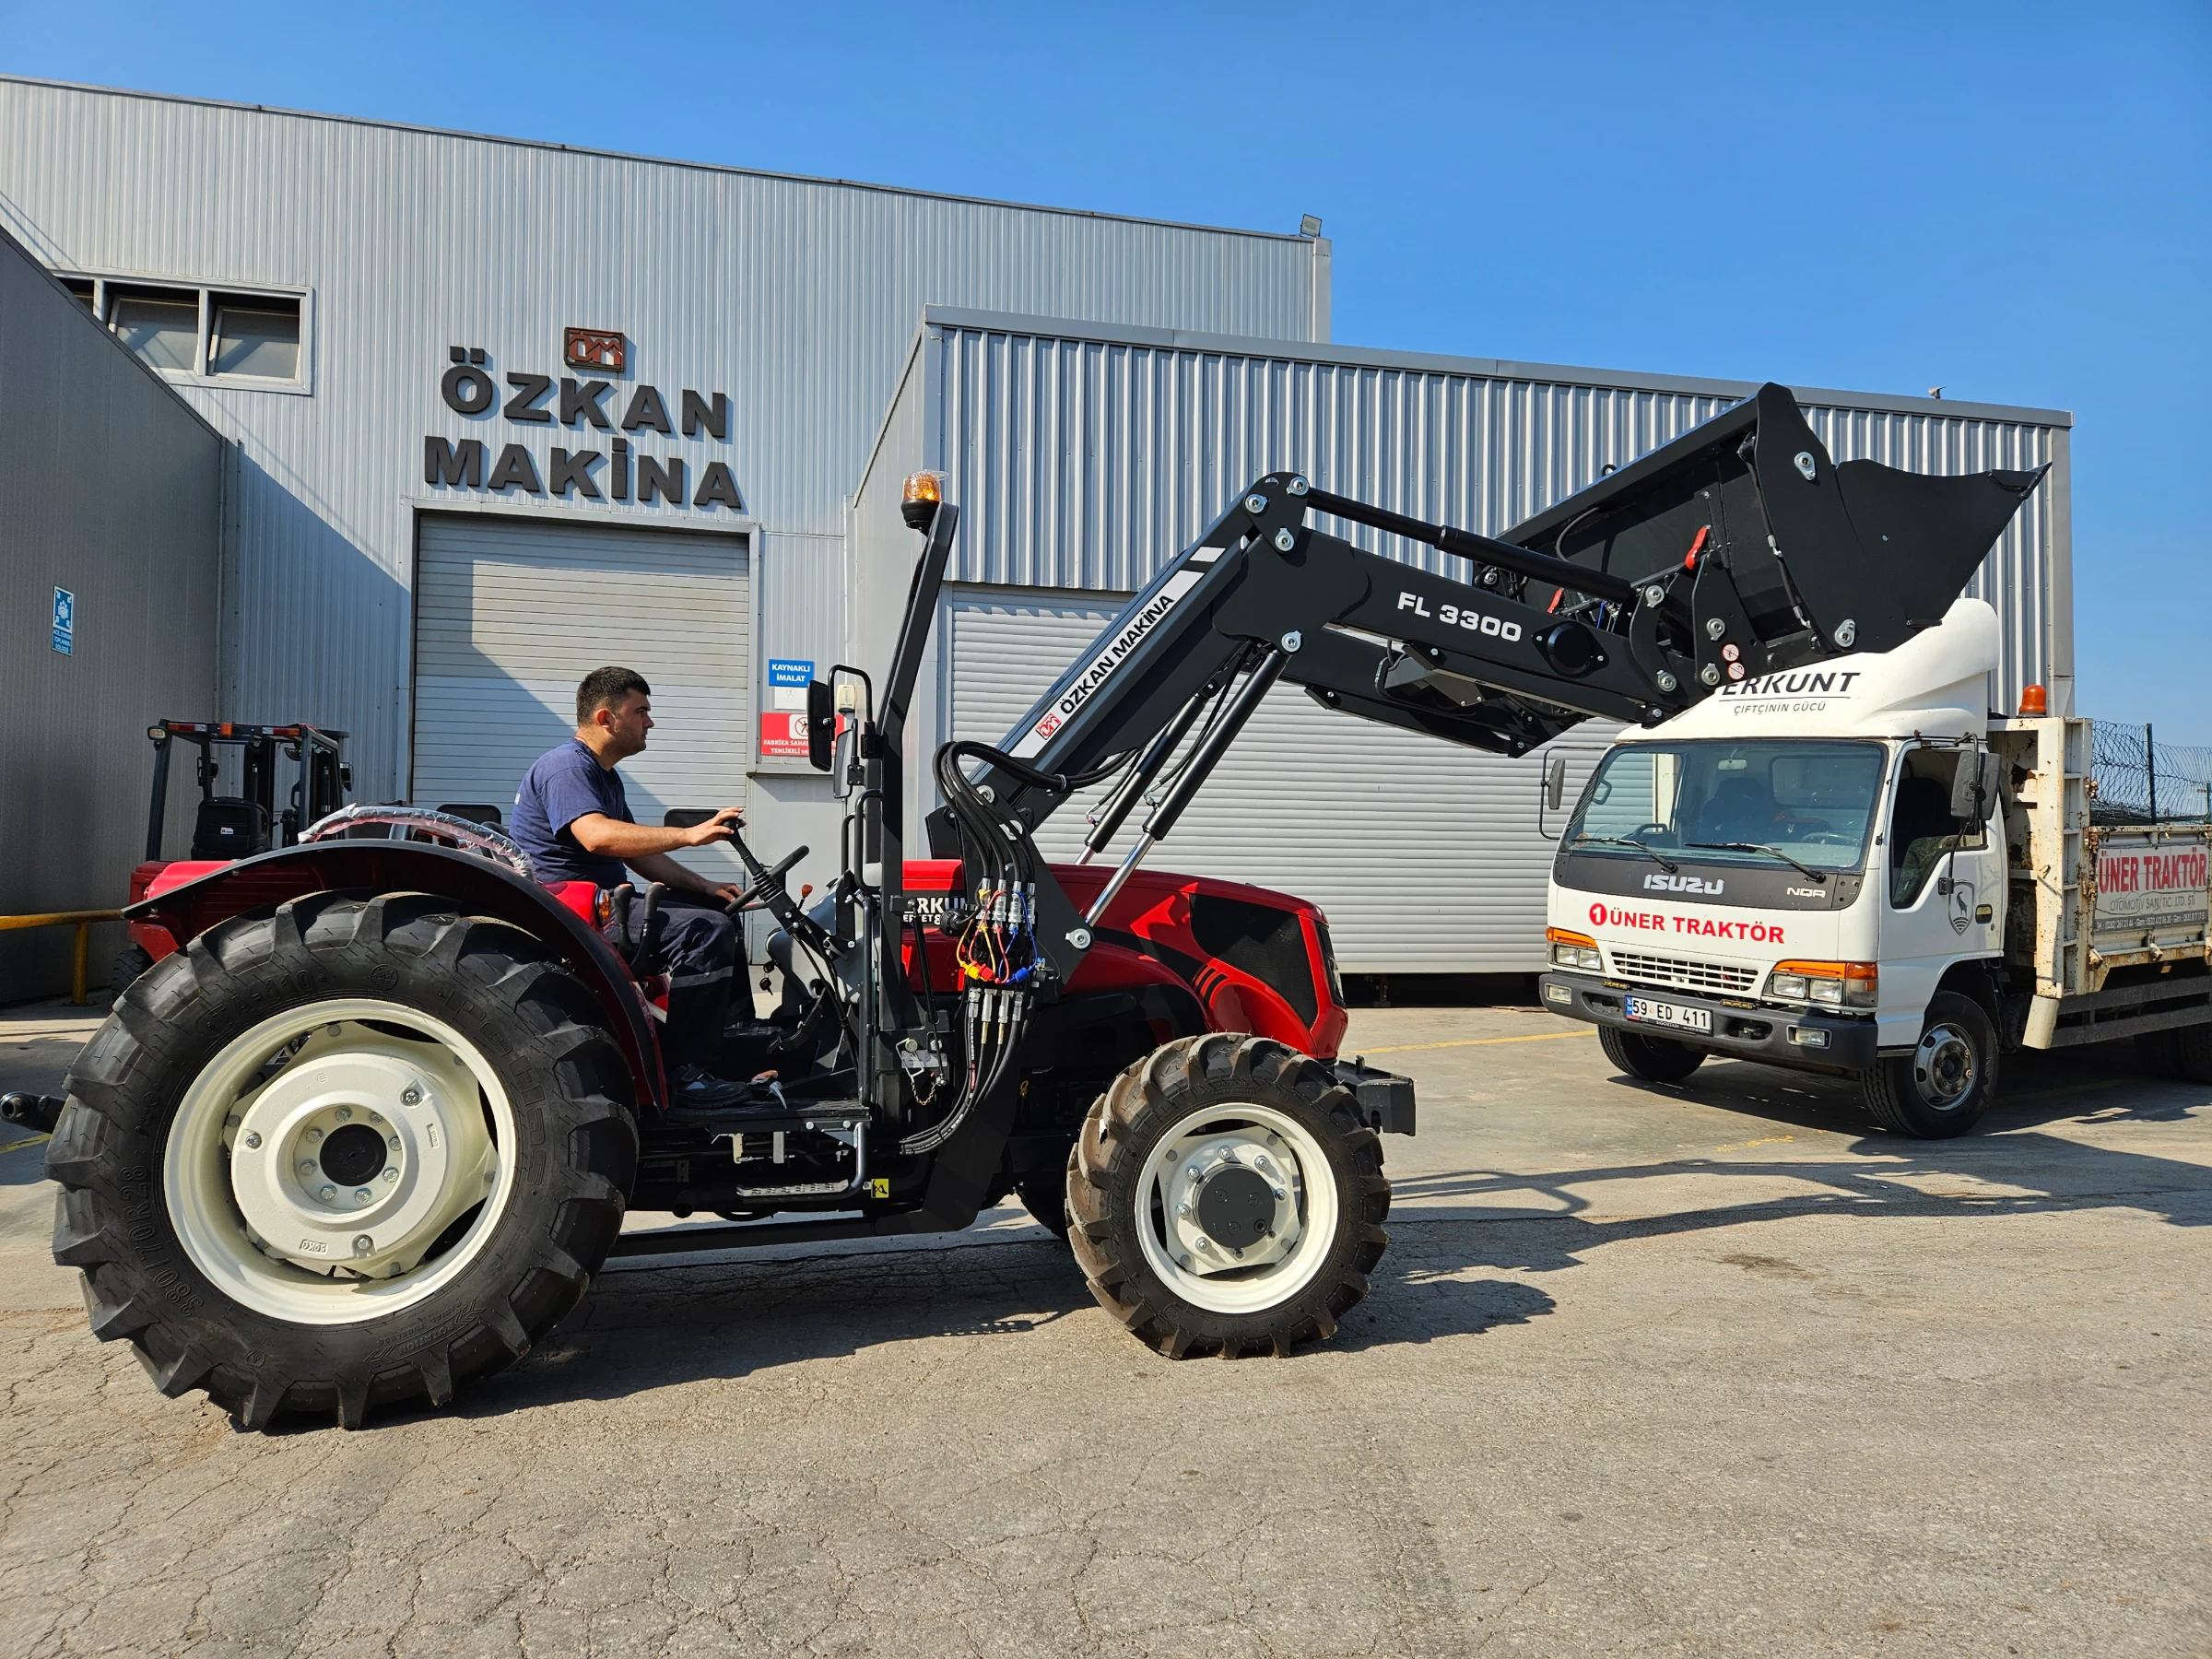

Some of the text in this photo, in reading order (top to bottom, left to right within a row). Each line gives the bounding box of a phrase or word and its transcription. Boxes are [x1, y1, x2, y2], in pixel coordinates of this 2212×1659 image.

[441, 345, 726, 439] ÖZKAN
[424, 436, 742, 510] MAKİNA
[1397, 591, 1522, 642] FL 3300
[1059, 594, 1175, 714] ÖZKAN MAKİNA
[771, 664, 810, 673] KAYNAKLI
[776, 673, 806, 682] İMALAT
[1734, 700, 1826, 715] ÇİFTÇİNİN GÜCÜ
[763, 738, 809, 747] FABRİKA SAHAS
[771, 747, 800, 755] TEHLİKELİ
[2099, 846, 2207, 894] ÜNER TRAKTÖR
[1643, 874, 1724, 895] ISUZU
[1786, 886, 1827, 899] NQR
[1609, 906, 1665, 932] ÜNER
[1673, 916, 1785, 944] TRAKTÖR
[1632, 1000, 1707, 1028] 59 ED 411
[119, 1164, 205, 1318] 380/70R28
